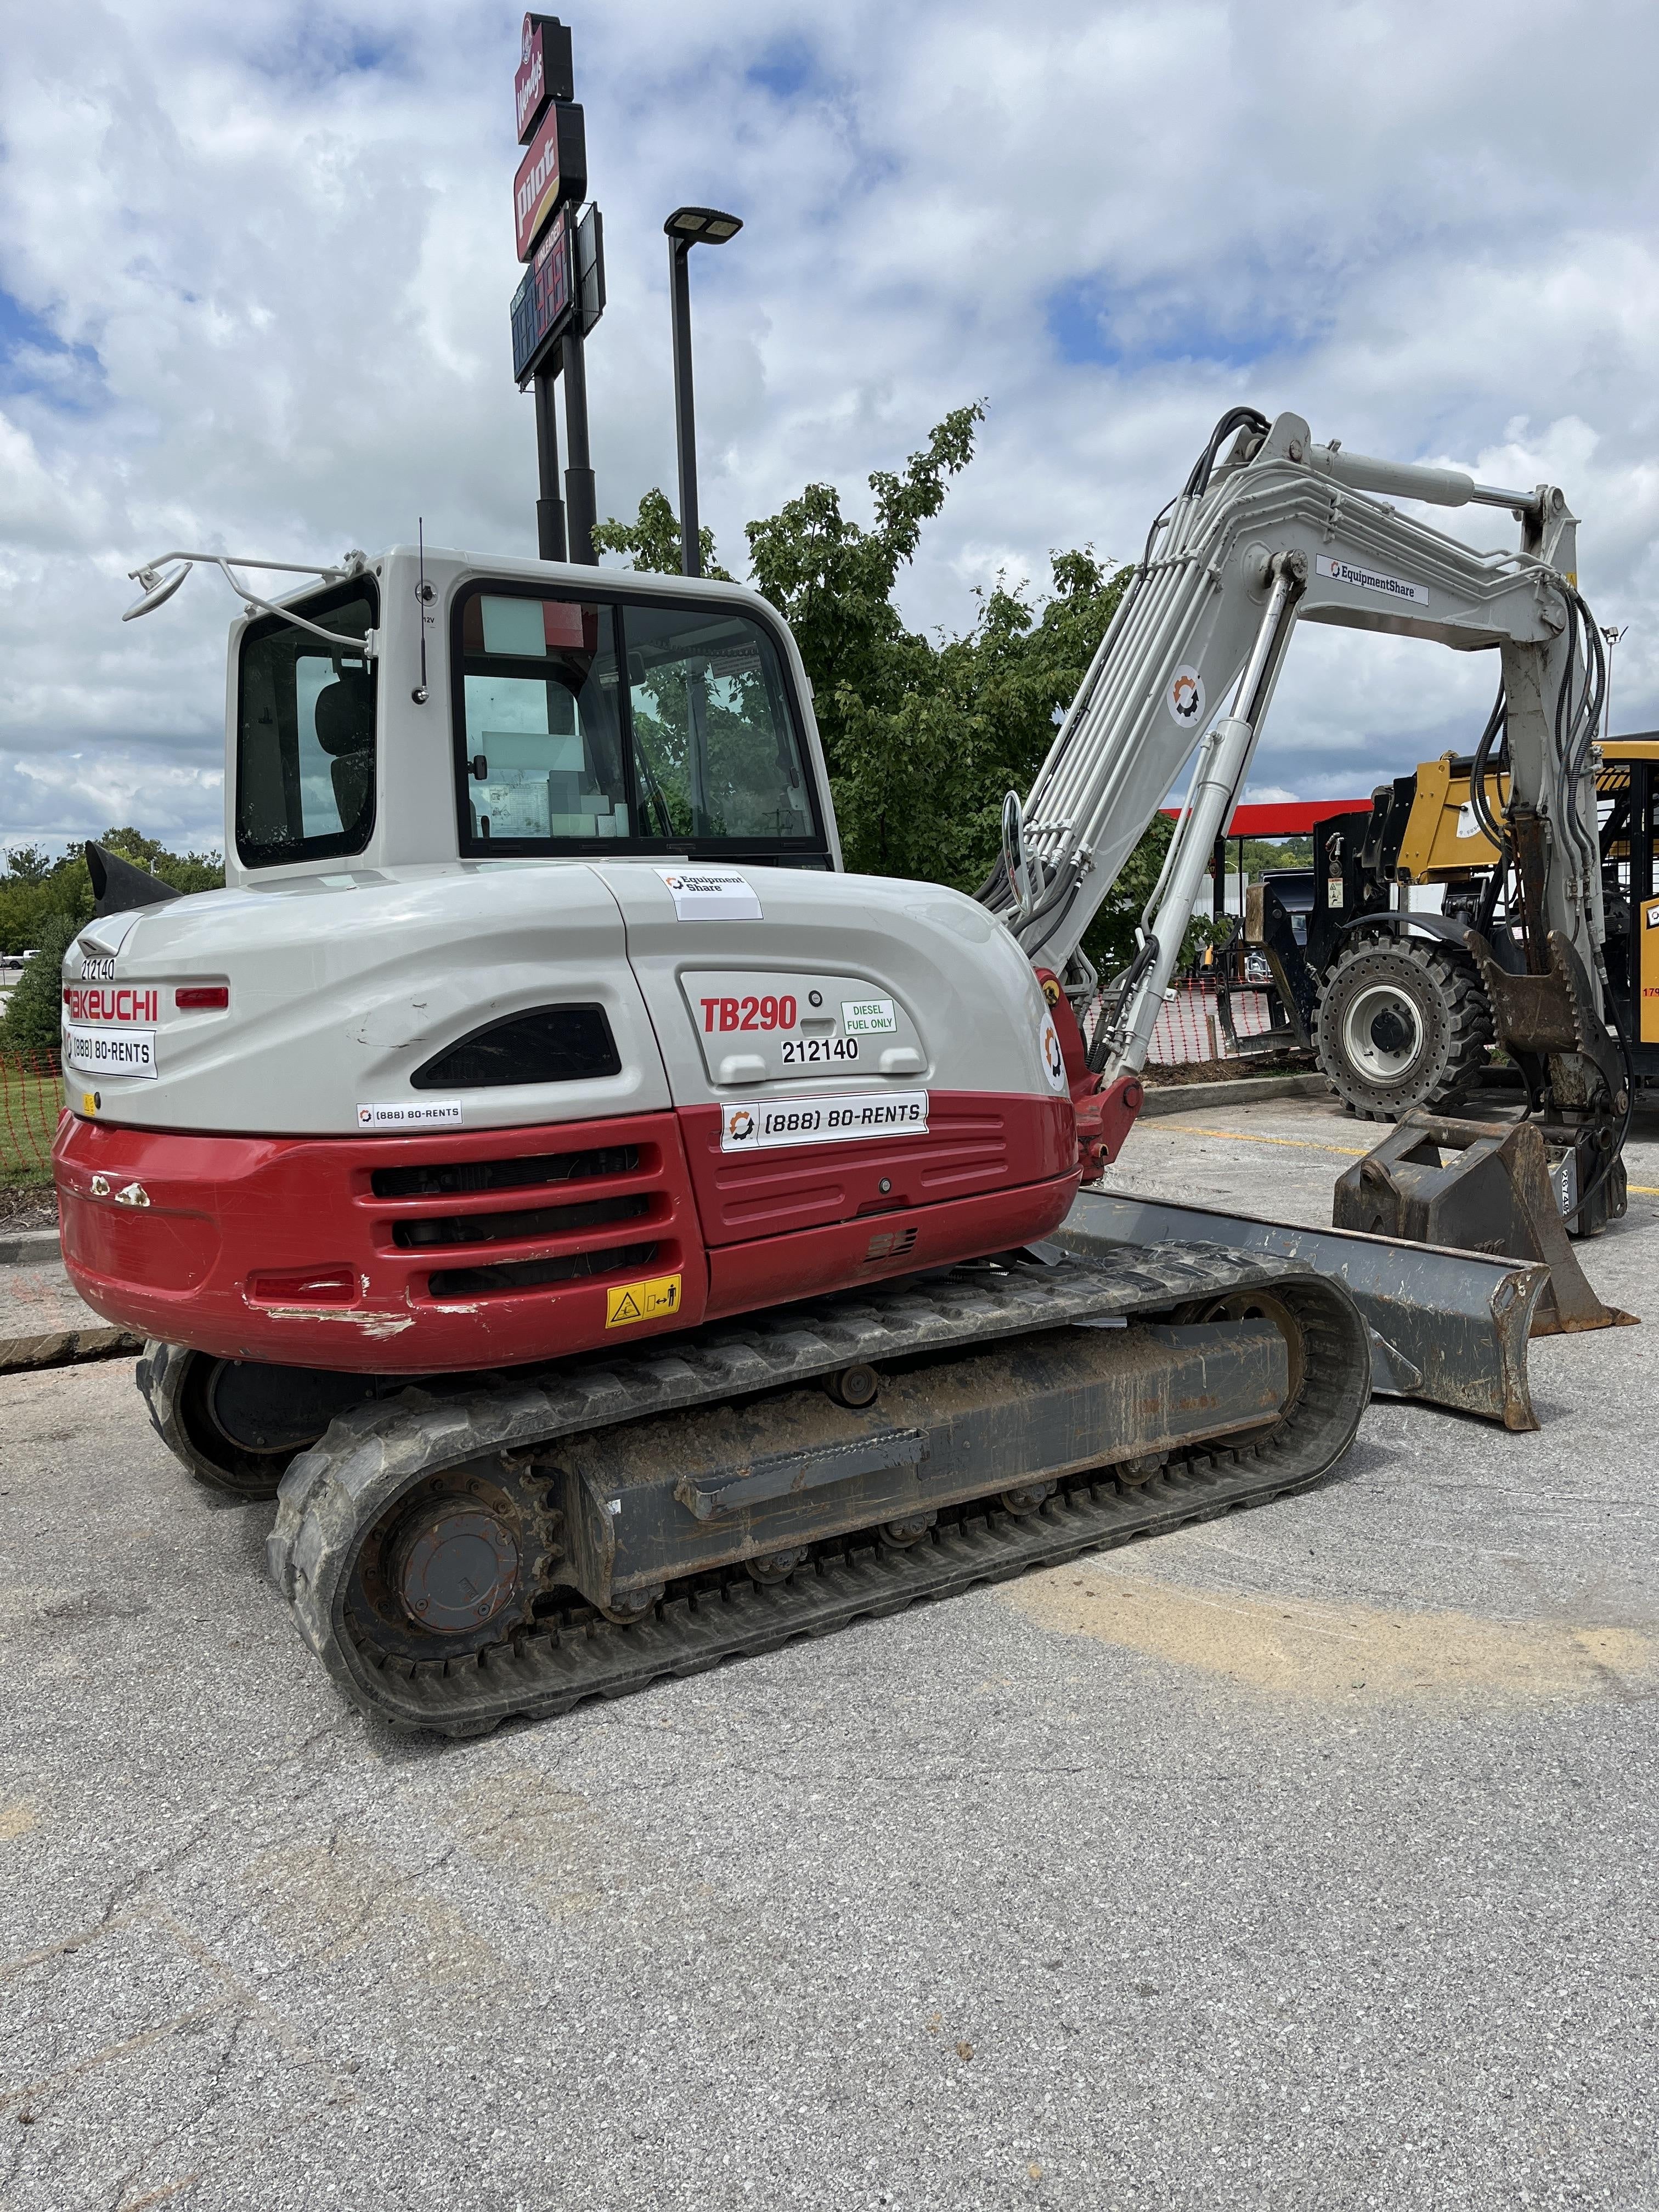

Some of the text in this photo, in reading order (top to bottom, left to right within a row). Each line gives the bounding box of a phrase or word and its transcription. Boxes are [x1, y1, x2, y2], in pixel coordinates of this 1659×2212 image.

[516, 51, 542, 131] Wendy's
[538, 221, 561, 267] UNLEADED
[1341, 565, 1414, 597] EquipmentShare
[679, 876, 745, 885] Equipment
[82, 958, 115, 980] 212140
[701, 995, 797, 1032] TB290
[853, 1005, 884, 1015] DIESEL
[847, 1018, 893, 1030] FUEL ONLY
[74, 1037, 149, 1063] (888) 80-RENTS
[782, 1038, 858, 1063] 212140
[376, 1108, 459, 1120] (888) 80-RENTS
[765, 1104, 920, 1135] (888) 80-RENTS
